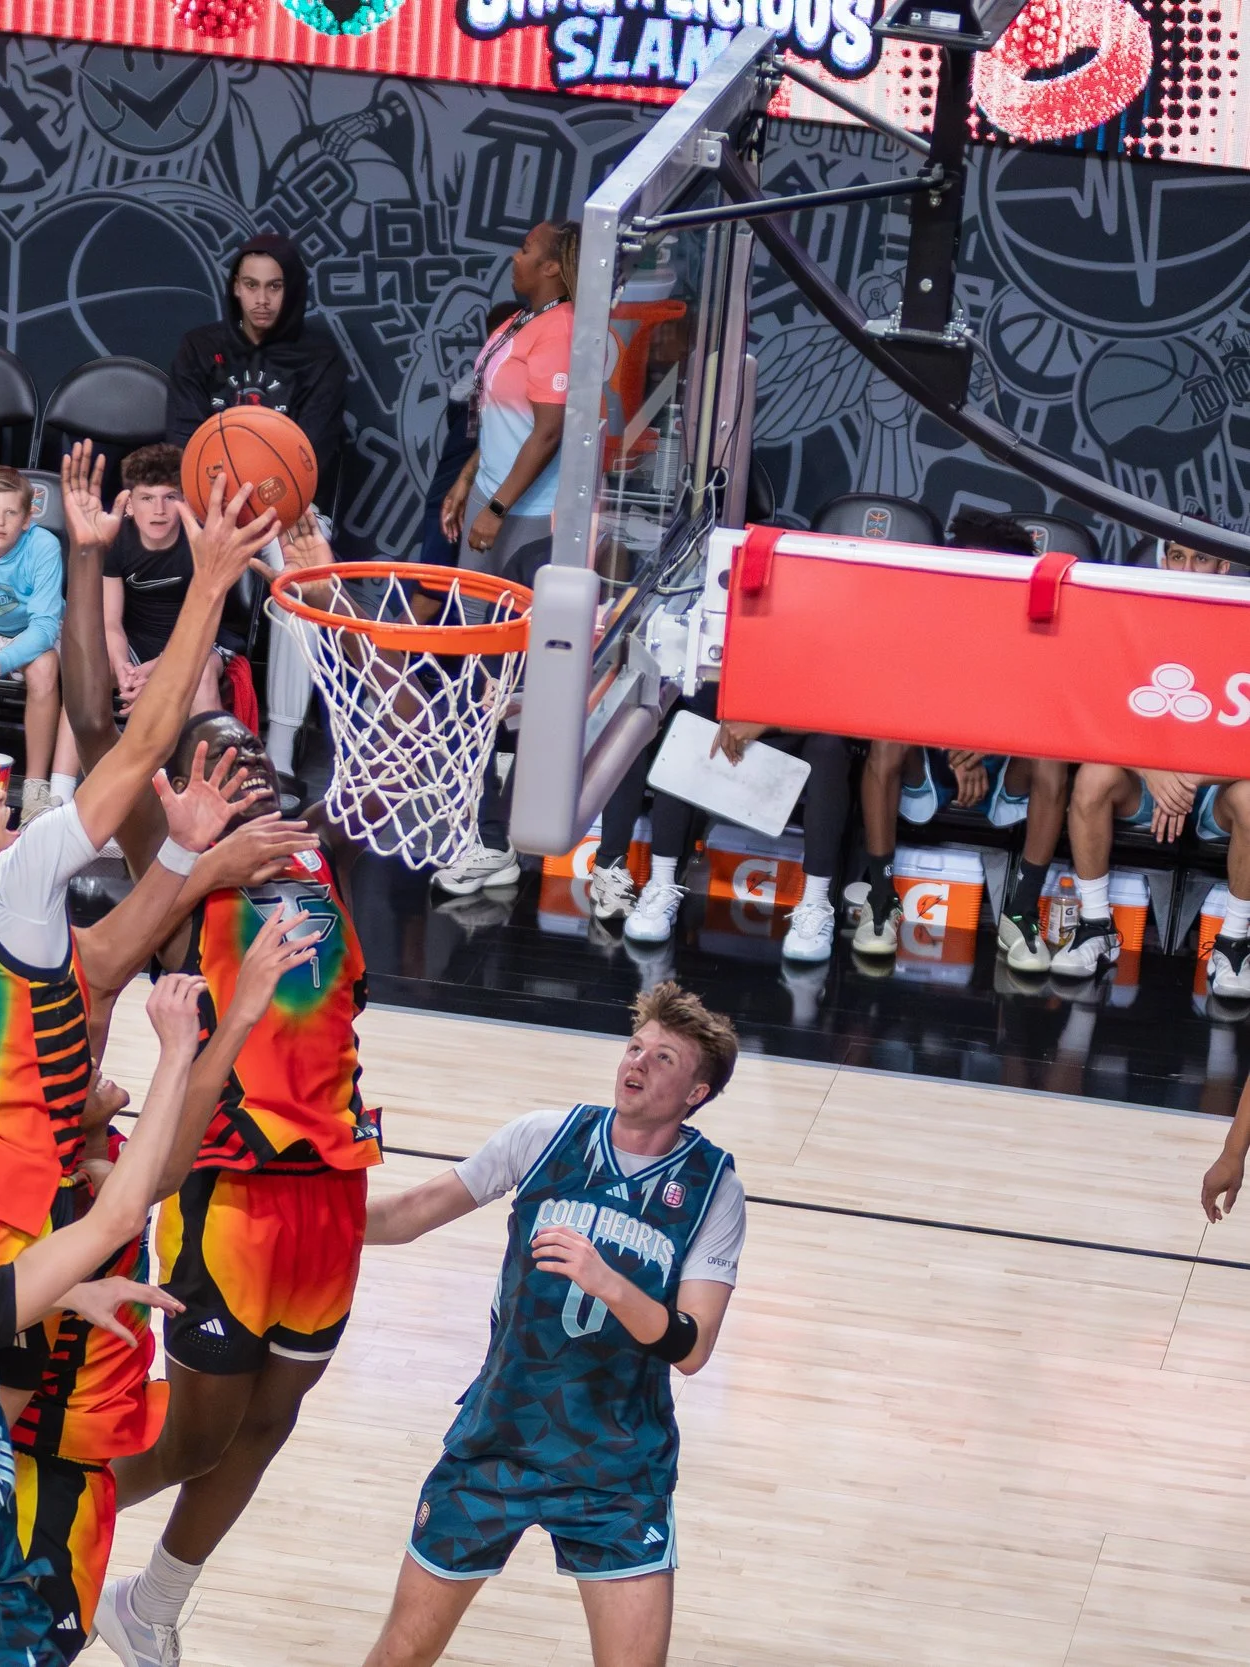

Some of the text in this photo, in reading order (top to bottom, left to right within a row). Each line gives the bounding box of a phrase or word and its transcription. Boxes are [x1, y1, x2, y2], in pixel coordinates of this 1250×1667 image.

[229, 369, 280, 389] CITY
[733, 858, 778, 904] G
[903, 883, 950, 926] G
[1065, 907, 1073, 916] G
[536, 1198, 676, 1266] COLD HEARTS
